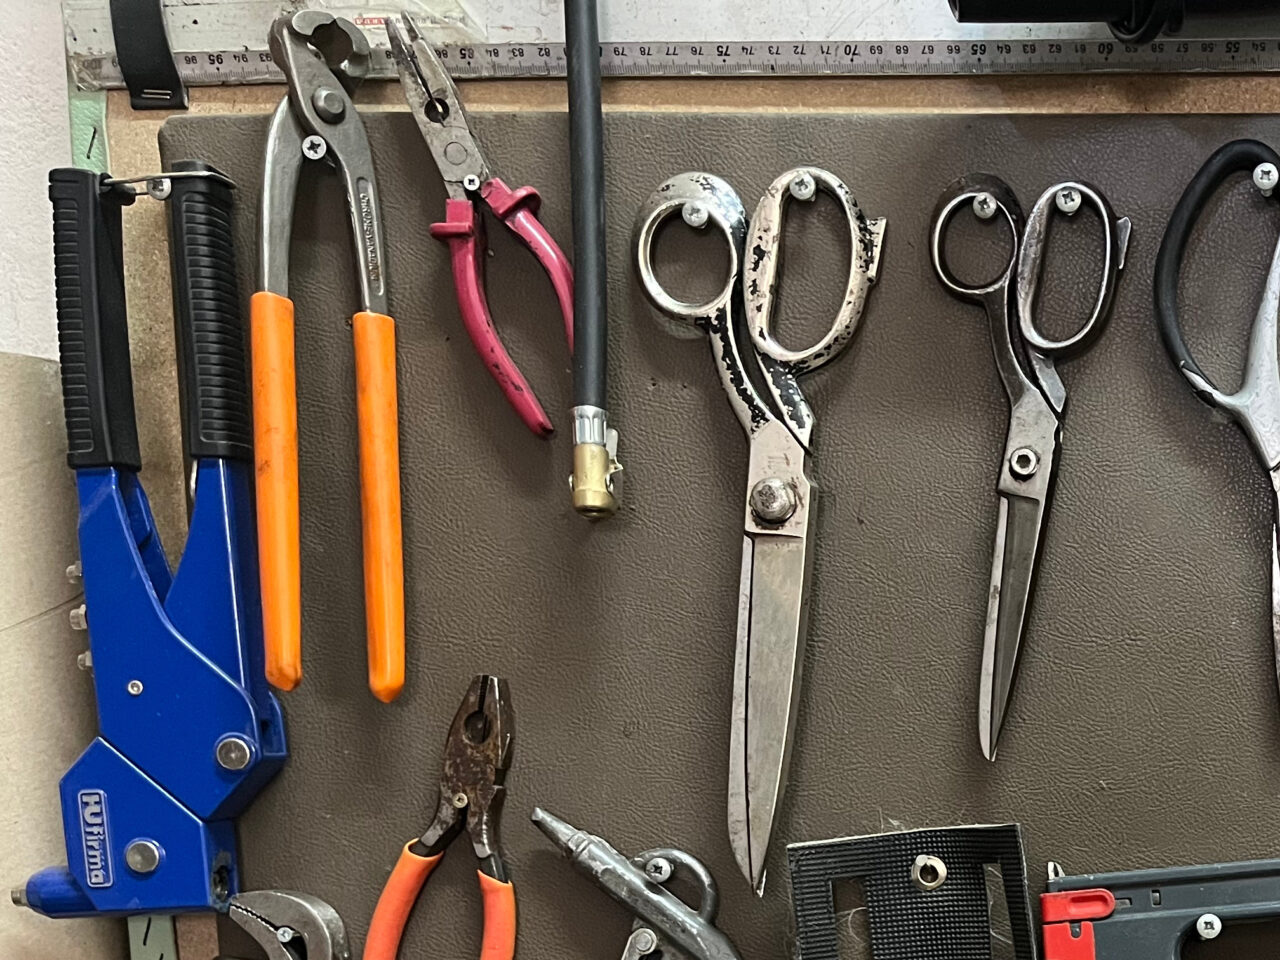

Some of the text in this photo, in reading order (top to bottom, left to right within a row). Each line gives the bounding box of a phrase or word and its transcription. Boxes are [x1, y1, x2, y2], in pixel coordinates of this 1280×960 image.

[666, 46, 678, 55] 77
[691, 46, 704, 55] 76
[717, 45, 730, 56] 75
[742, 46, 754, 55] 74
[768, 46, 780, 55] 73
[793, 44, 806, 55] 72
[820, 46, 832, 55] 71
[844, 45, 860, 56] 70
[870, 45, 882, 54] 69
[896, 45, 908, 54] 68
[922, 45, 934, 54] 67
[947, 45, 960, 54] 66
[971, 44, 986, 55] 65
[997, 44, 1011, 54] 64
[1022, 43, 1036, 54] 63
[1048, 44, 1062, 53] 62
[1075, 43, 1086, 54] 61
[1098, 43, 1113, 56] 60
[1151, 43, 1164, 53] 58
[1176, 43, 1188, 53] 57
[1201, 43, 1214, 52] 56
[1225, 41, 1240, 53] 55
[1252, 42, 1266, 51] 54
[460, 47, 474, 58] 85
[513, 48, 524, 57] 83
[537, 48, 550, 57] 82
[614, 47, 627, 56] 79
[640, 47, 652, 56] 78
[184, 55, 197, 64] 96
[208, 53, 223, 64] 95
[233, 54, 248, 62] 94
[81, 794, 105, 884] HUfirma
